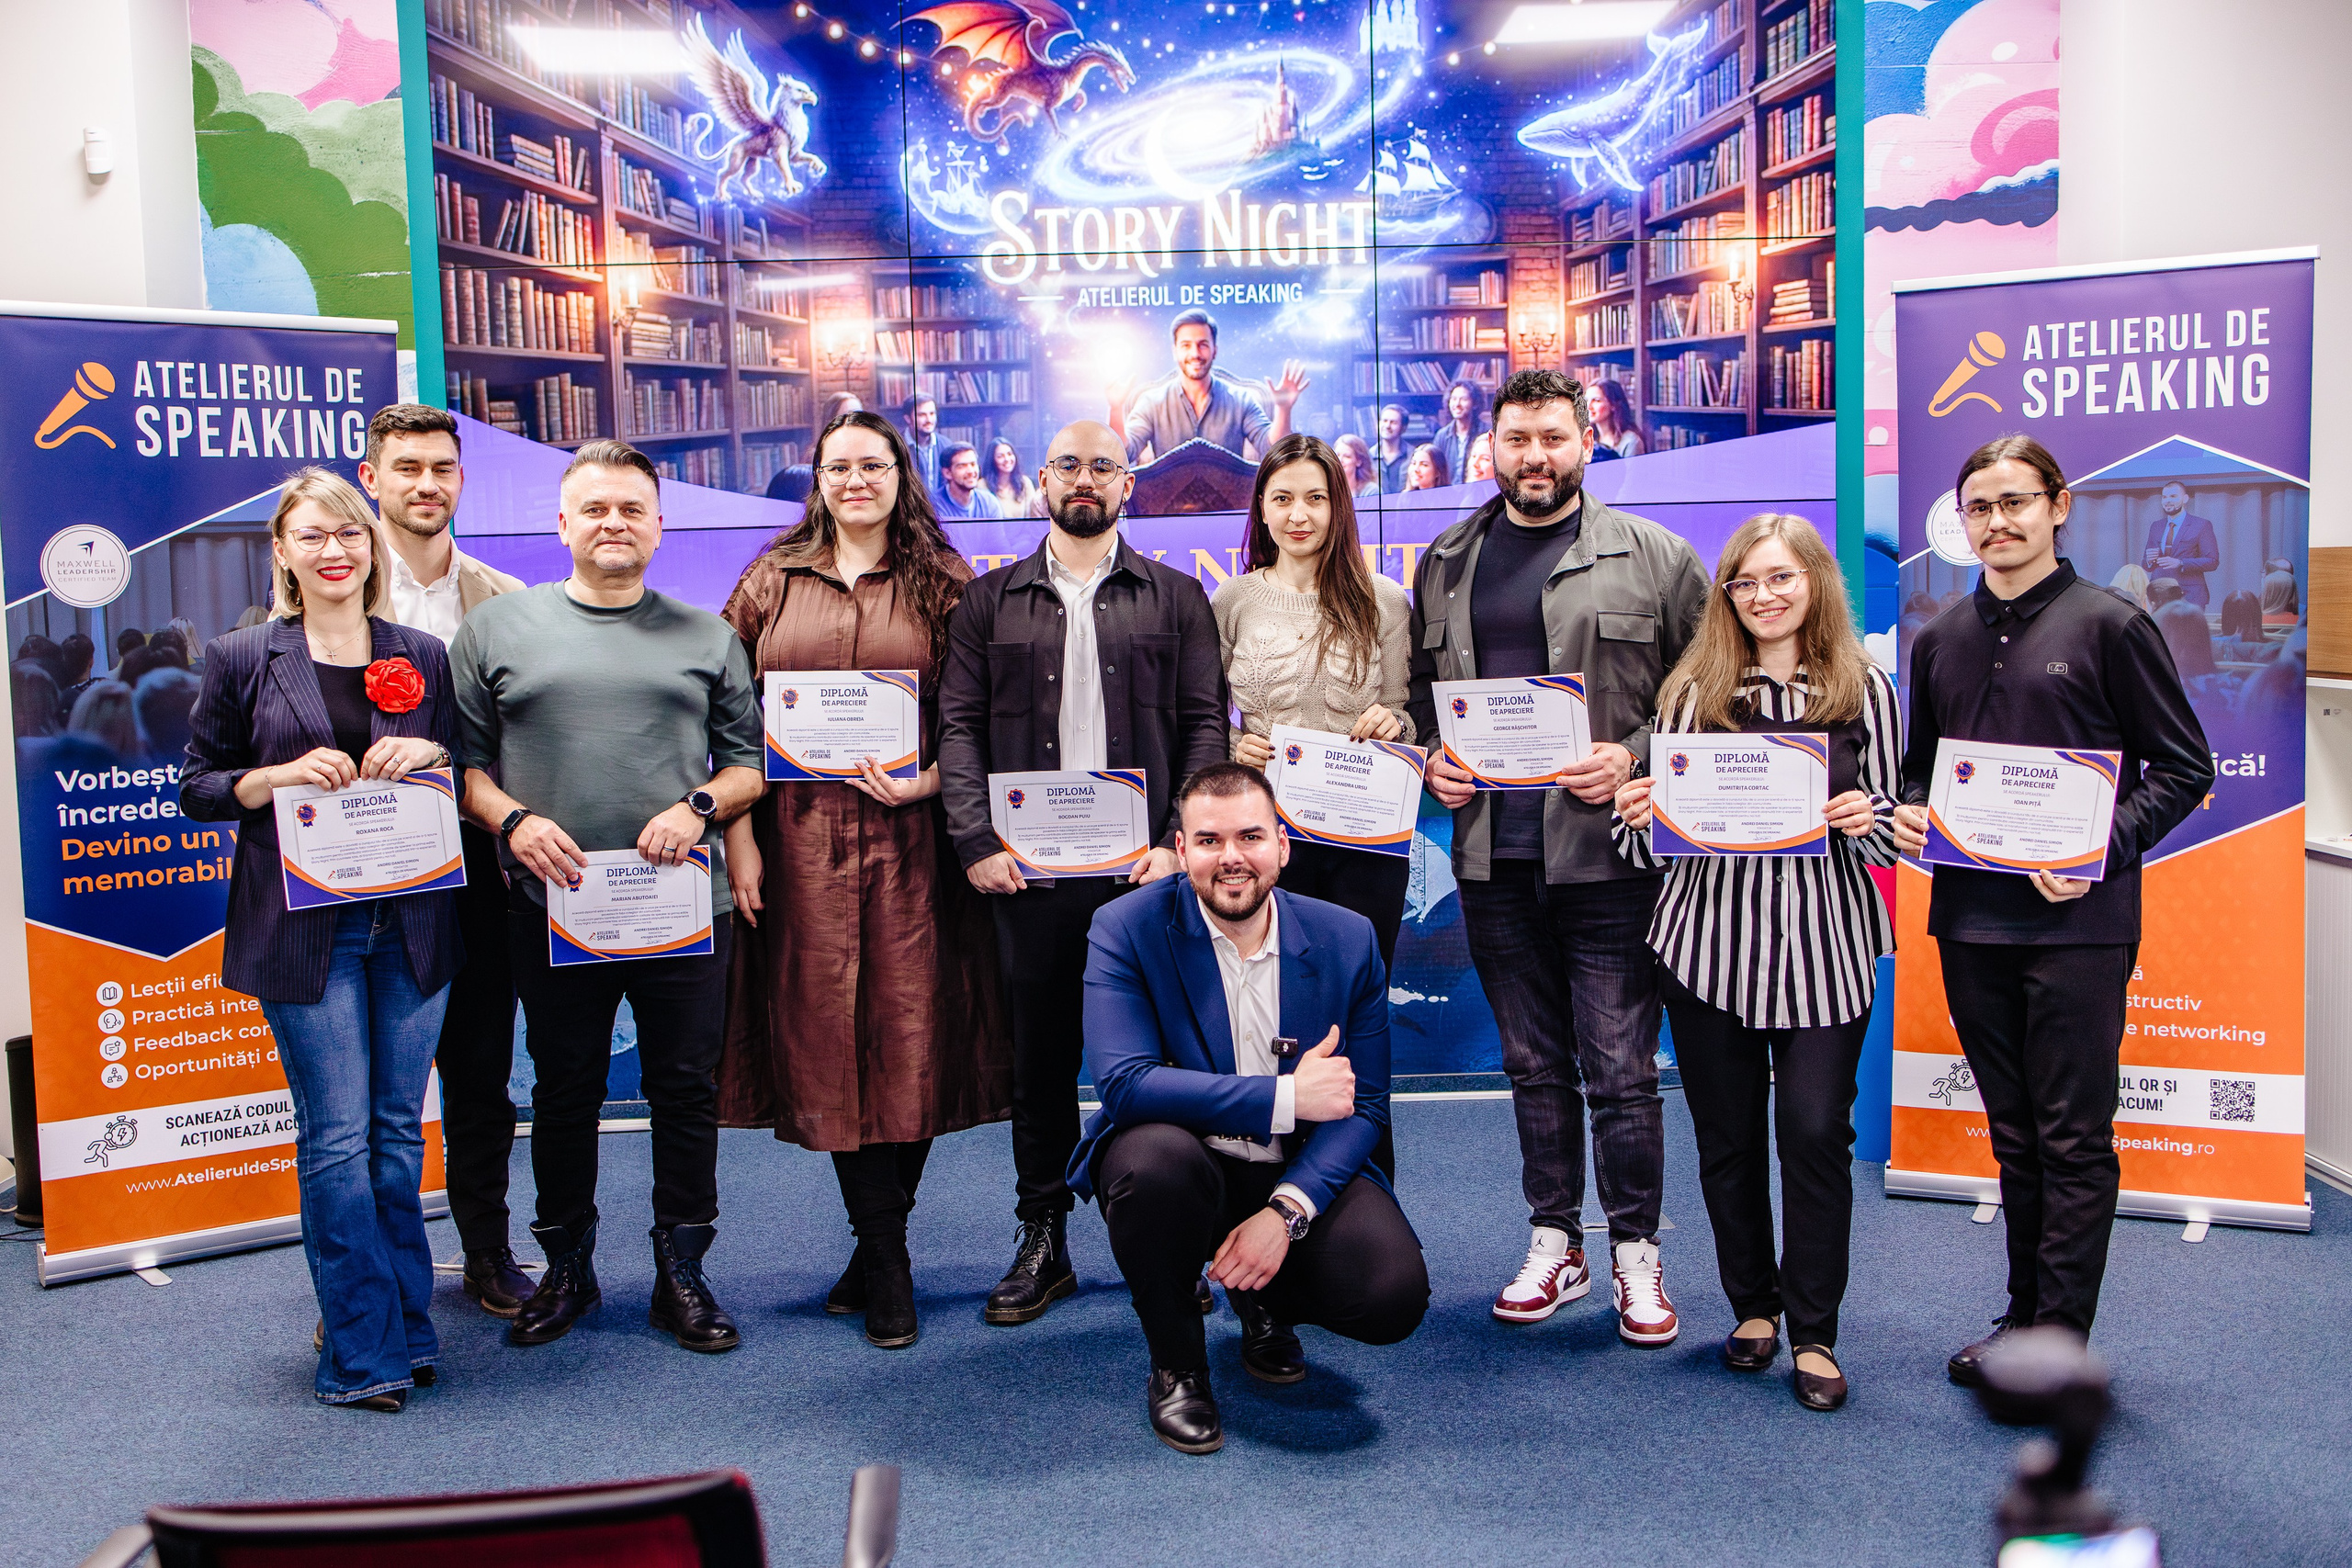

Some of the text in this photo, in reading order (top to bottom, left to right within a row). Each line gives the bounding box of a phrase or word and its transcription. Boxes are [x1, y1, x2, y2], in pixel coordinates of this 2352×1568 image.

[981, 188, 1379, 285] STORY NIGHT
[1077, 283, 1303, 308] ATELIERUL DE SPEAKING
[2023, 308, 2270, 362] ATELIERUL DE
[134, 360, 365, 404] ATELIERUL DE
[2022, 354, 2270, 419] SPEAKING
[135, 405, 367, 459] SPEAKING
[820, 687, 868, 697] DIPLOMĂ
[1487, 694, 1534, 705] DIPLOMĂ
[1325, 750, 1374, 766] DIPLOMĂ
[1714, 751, 1770, 762] DIPLOMĂ
[2211, 751, 2266, 777] ică!
[55, 764, 184, 793] Vorbeșt
[1335, 764, 1371, 774] APRECIERE
[2002, 765, 2058, 779] DIPLOMĂ
[1047, 785, 1096, 796] DIPLOMĂ
[1326, 780, 1354, 788] ALEXANDRA
[2014, 781, 2055, 789] APRECIERE
[341, 792, 398, 809] DIPLOMĂ
[356, 807, 397, 818] APRECIERE
[1304, 814, 1326, 822] SPEAKING
[62, 831, 172, 861] Devino
[181, 829, 220, 850] un
[1977, 838, 2003, 846] SPEAKING
[63, 856, 232, 895] memorabil
[337, 871, 363, 880] SPEAKING
[130, 976, 186, 998] Lecții
[132, 998, 263, 1025] Practică inte
[2126, 994, 2202, 1011] structiv
[134, 1026, 233, 1053] Feedback
[2125, 1023, 2266, 1046] e networking
[135, 1045, 279, 1080] Oportunități d
[2139, 1078, 2159, 1092] QR
[2164, 1079, 2177, 1096] ȘI
[165, 1100, 291, 1130] SCANEAZĂ CODUL
[180, 1120, 270, 1147] ACȚIONEAZĂ
[2111, 1134, 2215, 1156] Speaking.ro
[126, 1157, 298, 1193] www.AtelieruldeSpe
